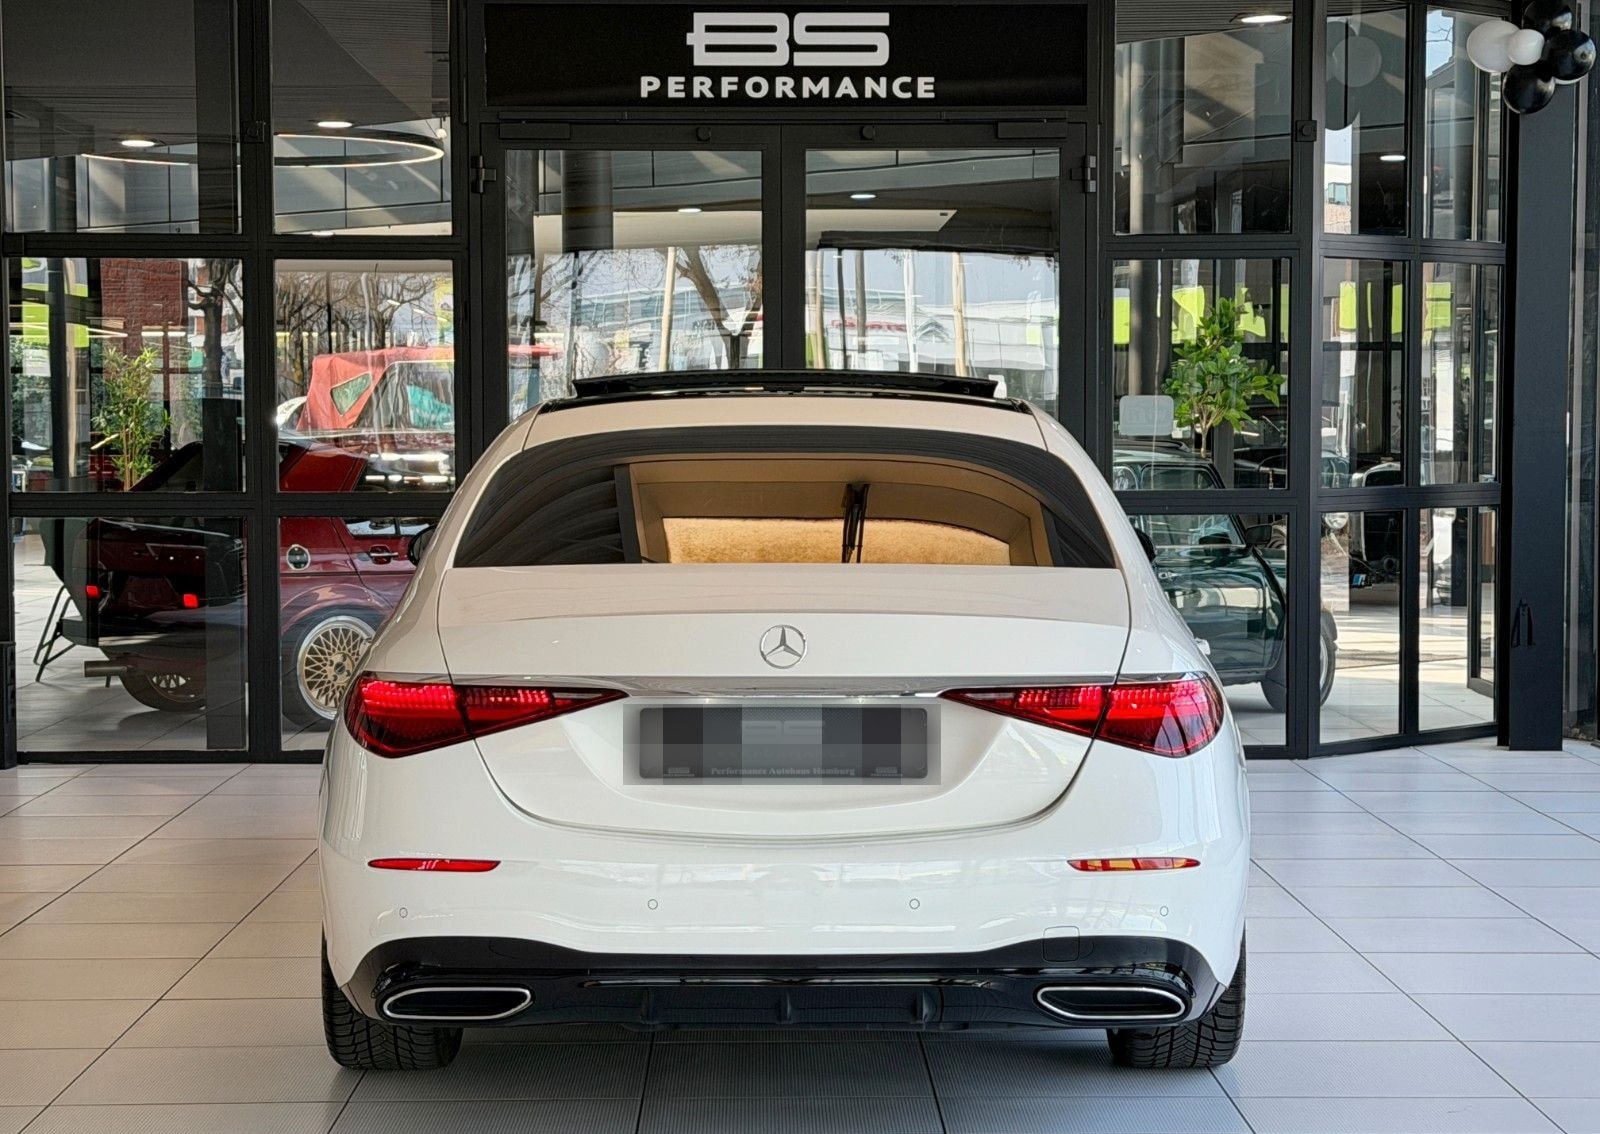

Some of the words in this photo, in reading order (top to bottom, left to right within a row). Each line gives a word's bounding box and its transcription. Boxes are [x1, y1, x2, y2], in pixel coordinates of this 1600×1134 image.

[686, 12, 890, 66] BS
[640, 76, 936, 98] PERFORMANCE
[711, 767, 768, 775] Performance
[768, 767, 811, 775] Autohaus
[812, 767, 856, 777] Hamburg
